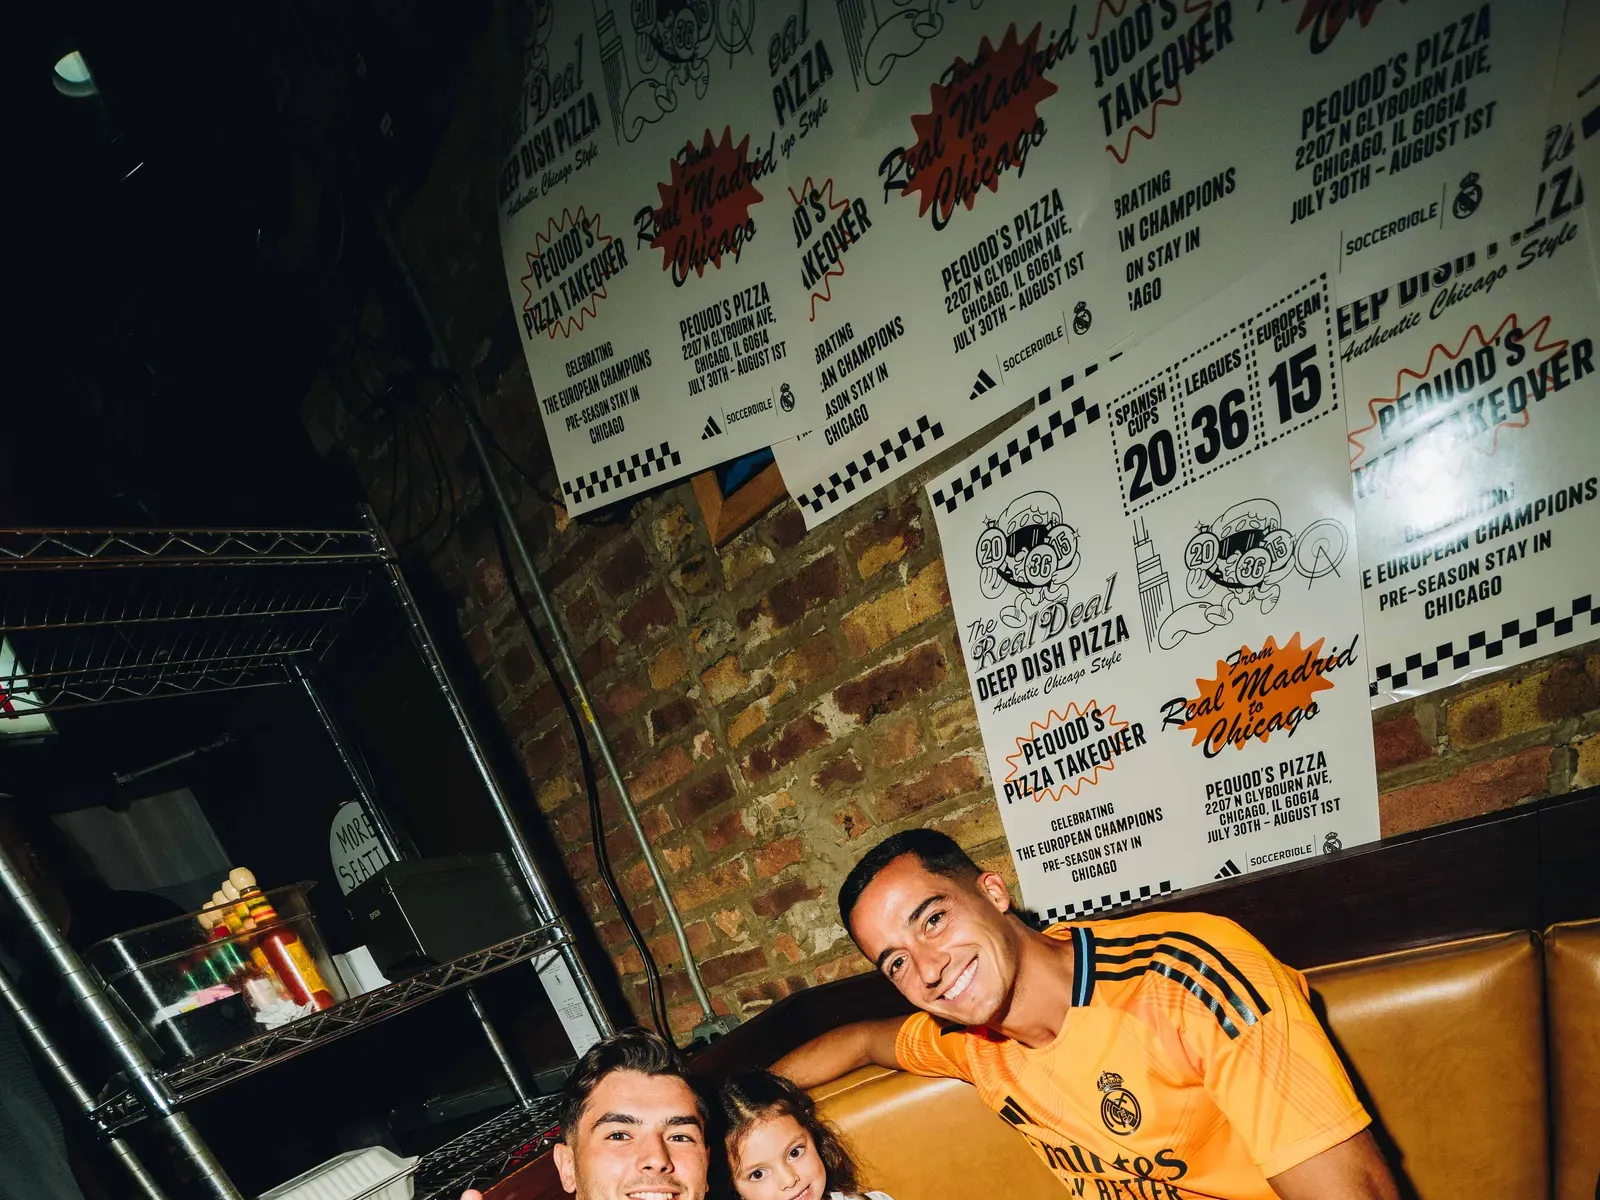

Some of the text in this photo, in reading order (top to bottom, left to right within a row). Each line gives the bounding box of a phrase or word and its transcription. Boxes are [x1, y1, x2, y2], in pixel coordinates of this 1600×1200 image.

[772, 39, 834, 128] PIZZA
[1098, 0, 1234, 137] TAKEOVER
[1302, 51, 1408, 141] PEQUOD'S
[1415, 2, 1491, 77] PIZZA
[879, 5, 1078, 205] Real Madrid
[1295, 45, 1492, 172] 2207 N CLYBOURN AVE,
[522, 91, 601, 178] DISH PIZZA
[1312, 87, 1467, 187] CHICAGO, IL 60614
[932, 117, 1047, 232] Chicago
[1290, 100, 1497, 226] JULY 30TH AUGUST 1ST
[634, 132, 777, 251] Real Madrid
[1139, 166, 1237, 242] CHAMPIONS
[531, 217, 594, 290] PEQUOD'S
[672, 218, 757, 288] Chicago
[941, 188, 1065, 291] PEQUOD'S PIZZA
[1147, 235, 1181, 273] STAY
[1185, 225, 1201, 252] IN
[1345, 201, 1439, 257] SOCCERBIBLE
[522, 238, 629, 341] PIZZA TAKEOVER
[944, 215, 1073, 314] 2207 N CLYBOURN AVE,
[962, 244, 1062, 325] CHICAGO, IL 60614
[1341, 221, 1578, 363] Authentic Chicago Style
[679, 281, 771, 342] PEQUOD'S PIZZA
[953, 251, 1085, 354] JULY 30TH AUGUST 1ST
[1256, 292, 1322, 346] EUROPEAN
[565, 341, 615, 378] CELEBRATING
[682, 337, 704, 361] 2207
[704, 334, 711, 352] N
[711, 318, 755, 350] CLYBOURN
[694, 328, 769, 375] CHICAGO, IL 60614
[1002, 325, 1064, 372] SOCCERBIBLE
[1273, 320, 1307, 353] CUPS
[1184, 348, 1242, 396] LEAGUES
[1268, 344, 1322, 425] 15
[589, 415, 625, 444] CHICAGO
[824, 403, 871, 446] CHICAGO
[1115, 382, 1167, 428] SPANISH
[1127, 408, 1159, 438] CUPS
[1191, 388, 1249, 465] 36
[1124, 429, 1177, 502] 20
[981, 536, 1003, 565] 20
[1051, 531, 1072, 561] 15
[1190, 542, 1215, 566] 20
[1377, 534, 1469, 584] EUROPEAN
[1475, 477, 1599, 545] CHAMPIONS
[1029, 554, 1052, 577] 36
[1241, 556, 1266, 578] 36
[1379, 530, 1552, 611] PRE-SEASON STAY IN
[971, 572, 1118, 673] Real Deal
[1424, 575, 1502, 620] CHICAGO
[967, 617, 998, 643] The
[977, 615, 1130, 701] DEEP DISH PIZZA
[993, 651, 1122, 714] Authentic Chicago Style
[1160, 634, 1359, 732] Real Madrid
[1226, 646, 1274, 676] From
[1203, 701, 1320, 759] Chicago
[1248, 698, 1264, 716] to
[1003, 722, 1147, 804] PIZZA TAKEOVER
[1022, 708, 1105, 765] PEQUOD'S
[1205, 751, 1327, 800] PEQUOD'S PIZZA
[1205, 770, 1333, 815] 2207 N CLYBOURN AVE,
[336, 813, 377, 855] MORE
[1016, 807, 1163, 861] THE EUROPEAN CHAMPIONS
[1051, 802, 1115, 832] CELEBRATING
[1207, 797, 1341, 843] JULY 30TH AUGUST 1ST
[1220, 788, 1320, 826] CHICAGO, IL 60614
[1043, 835, 1142, 873] PRE-SEASON STAY IN
[1072, 859, 1117, 882] CHICAGO
[1250, 844, 1313, 867] SOCCERBIBLE
